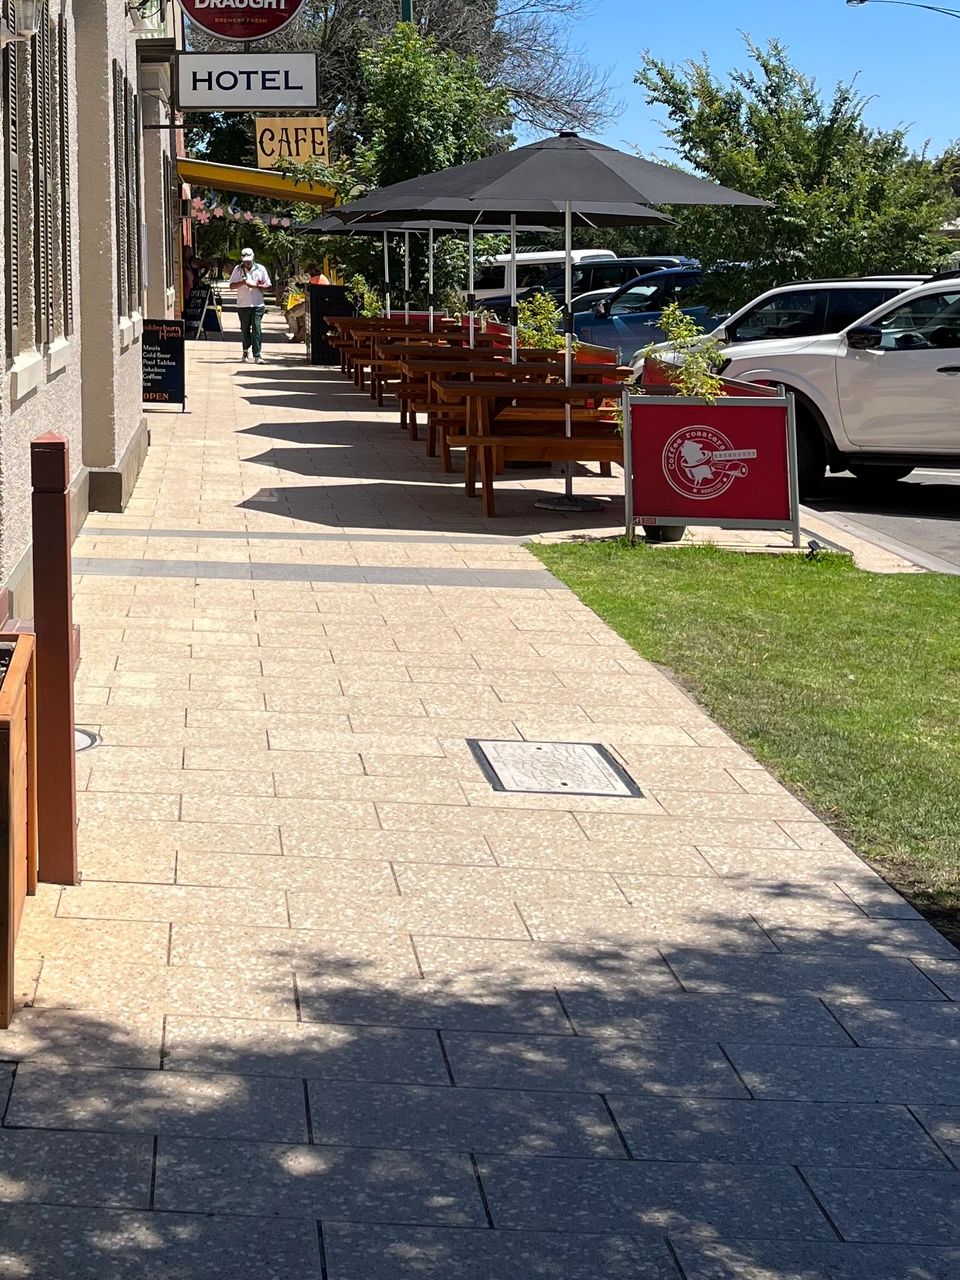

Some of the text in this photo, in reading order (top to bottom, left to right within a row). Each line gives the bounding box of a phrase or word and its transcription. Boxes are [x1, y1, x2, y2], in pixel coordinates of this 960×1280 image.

[191, 70, 304, 91] HOTEL
[258, 127, 326, 158] CAFE
[143, 392, 169, 400] OPEN
[685, 431, 725, 450] roasters
